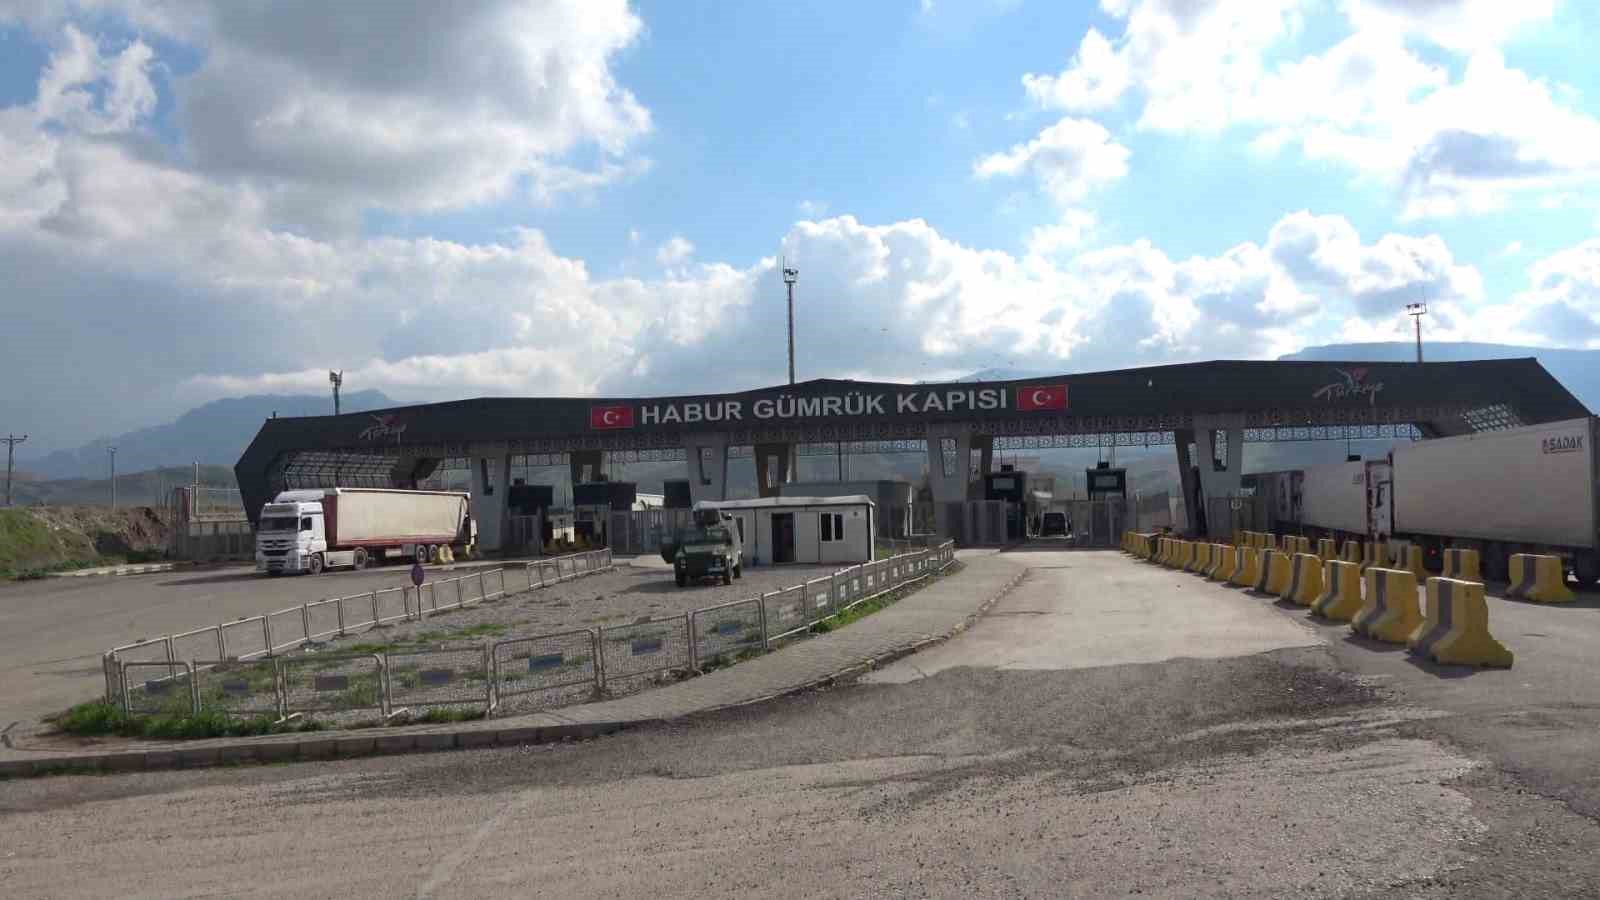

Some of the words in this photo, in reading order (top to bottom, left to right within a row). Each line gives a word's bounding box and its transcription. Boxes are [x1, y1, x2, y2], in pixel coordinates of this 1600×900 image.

[640, 401, 743, 425] HABUR
[752, 391, 885, 418] GÜMRÜK
[896, 388, 1007, 413] KAPISI
